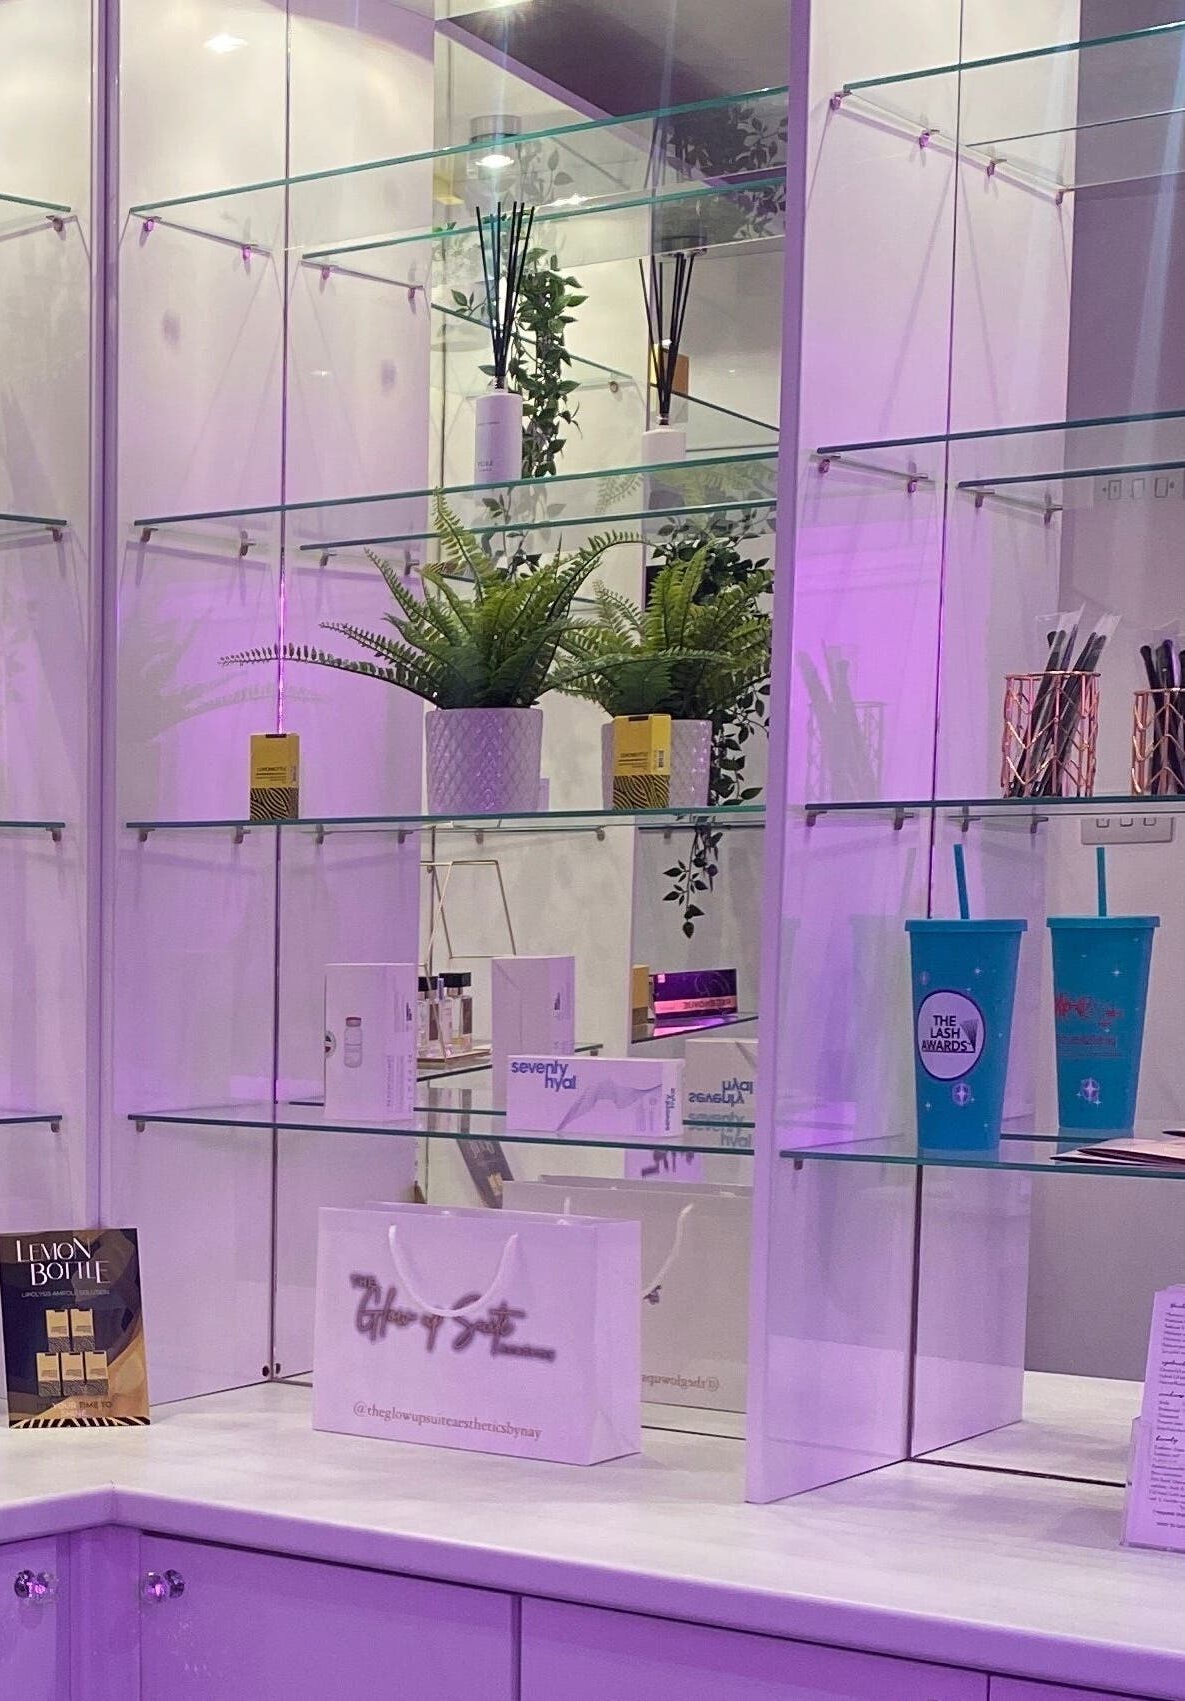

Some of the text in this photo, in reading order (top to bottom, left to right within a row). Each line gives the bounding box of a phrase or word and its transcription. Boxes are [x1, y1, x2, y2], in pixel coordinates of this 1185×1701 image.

[933, 1015, 956, 1026] THE
[930, 1028, 960, 1039] LASH
[922, 1040, 968, 1051] AWARDS
[511, 1060, 569, 1077] seventy
[544, 1075, 577, 1092] hyal
[16, 1237, 91, 1262] LEMON
[30, 1260, 111, 1286] BOTTLE
